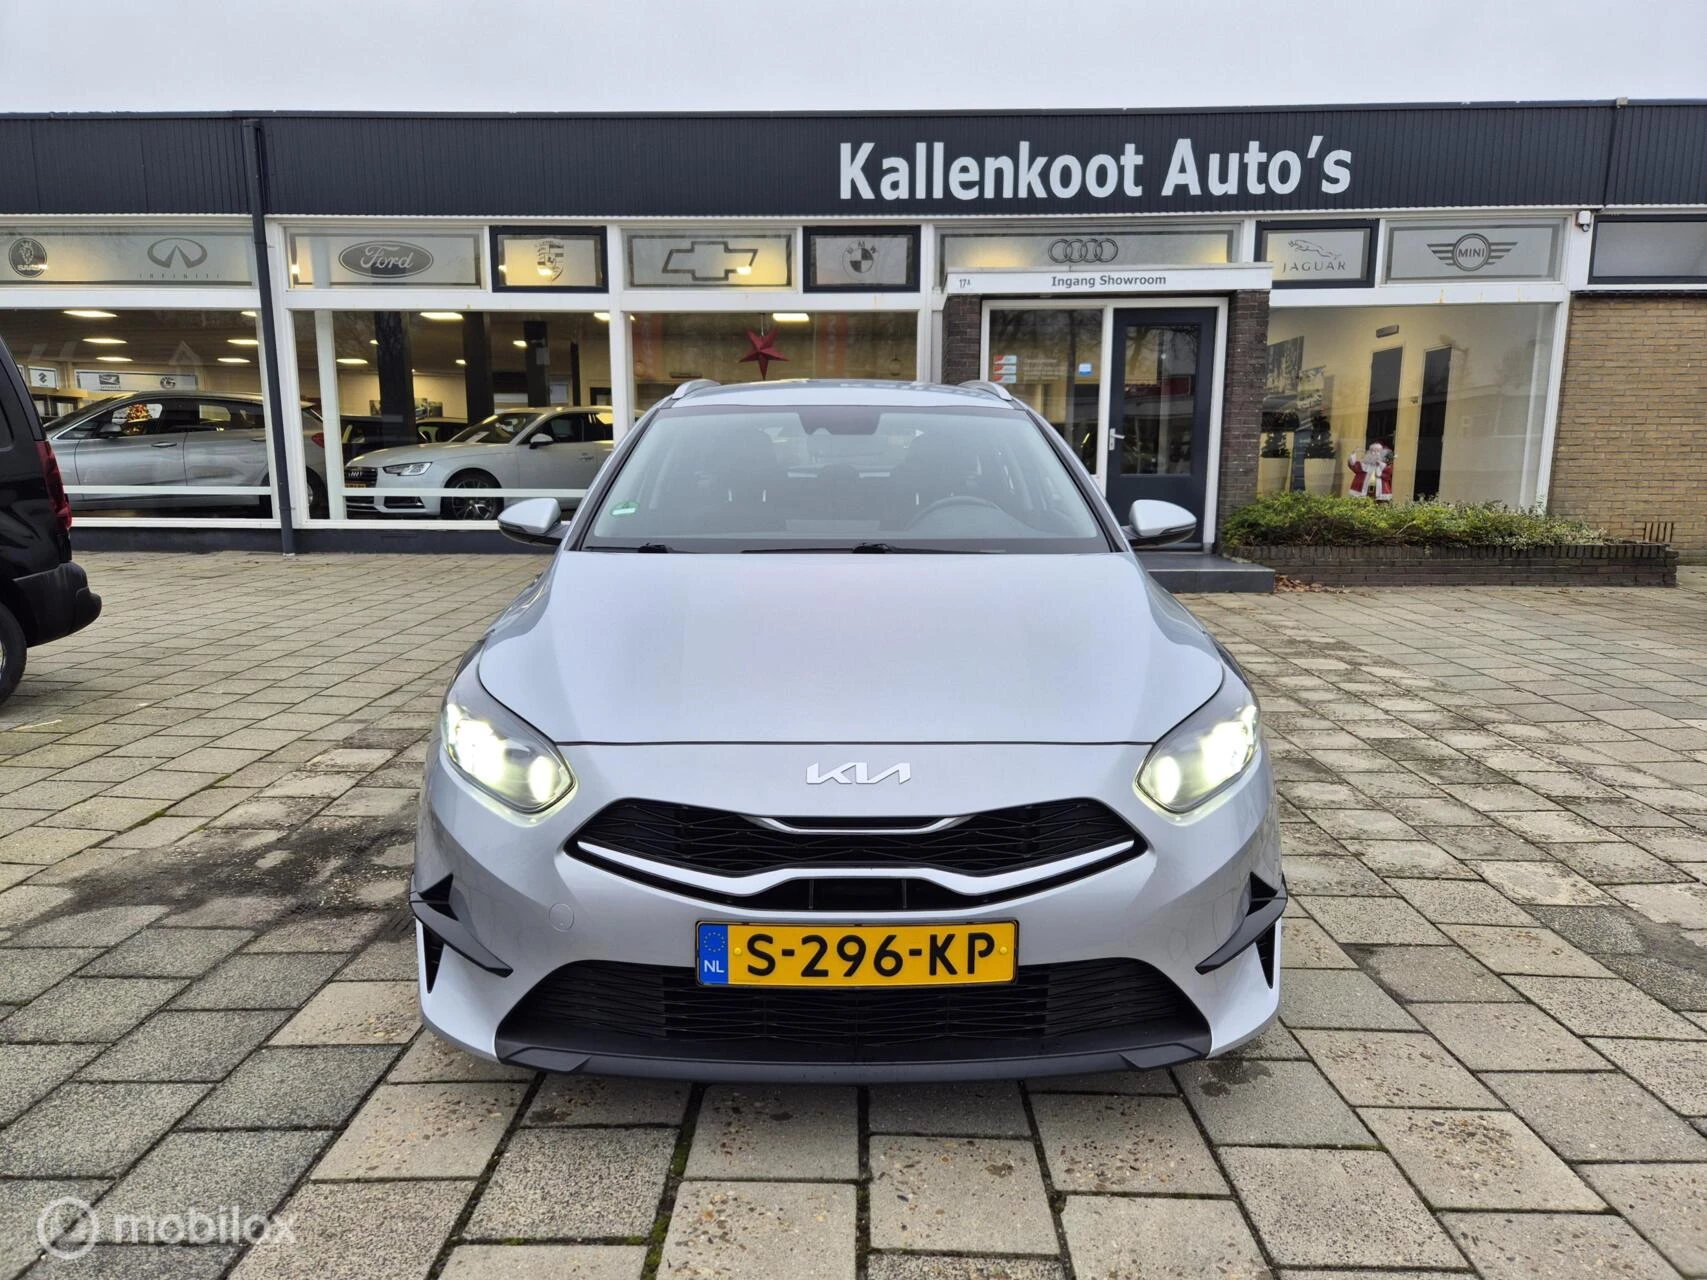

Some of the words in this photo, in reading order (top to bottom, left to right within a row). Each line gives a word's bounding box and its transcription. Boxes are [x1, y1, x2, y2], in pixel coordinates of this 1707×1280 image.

[840, 141, 1143, 200] Kallenkoot
[1161, 135, 1352, 197] Auto's
[360, 245, 414, 269] Ford
[1458, 247, 1485, 257] MINI
[1282, 261, 1347, 273] JAGUAR
[1051, 276, 1096, 289] Ingang
[1099, 274, 1167, 286] Showroom
[806, 761, 912, 785] KIA
[746, 932, 996, 978] S-296-KP
[703, 959, 725, 974] NL
